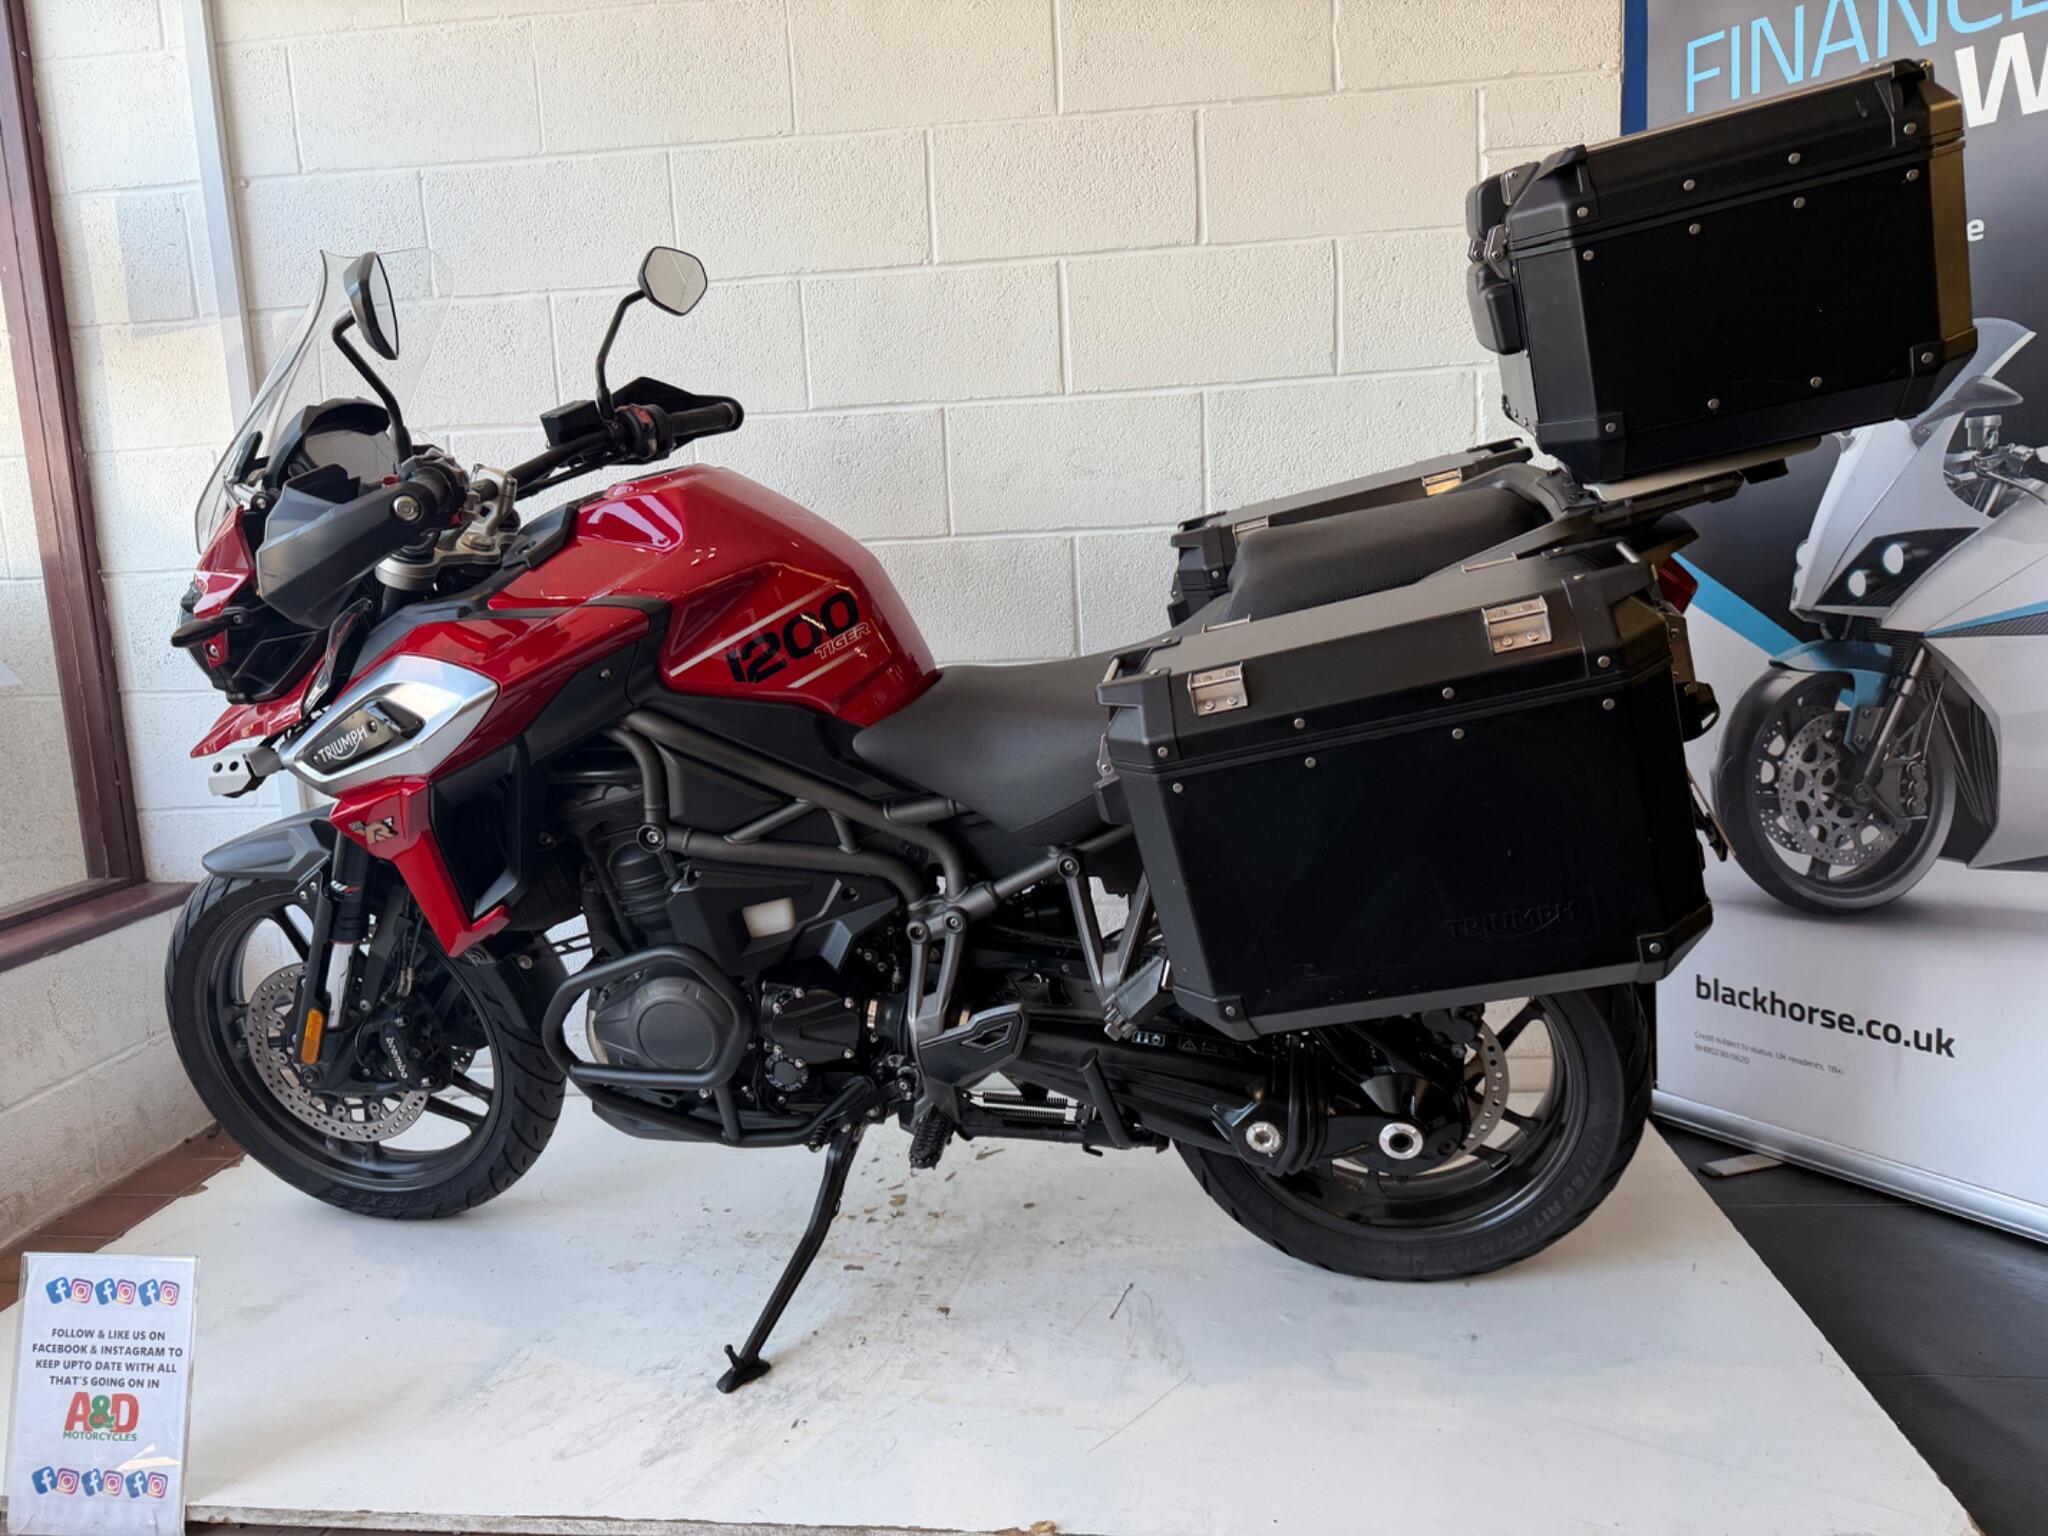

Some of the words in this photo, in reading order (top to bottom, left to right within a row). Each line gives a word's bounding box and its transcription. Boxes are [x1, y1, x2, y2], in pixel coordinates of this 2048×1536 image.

[1686, 0, 2048, 113] FINAN
[726, 591, 858, 683] 1200
[814, 622, 871, 660] TIGER
[318, 725, 368, 762] TRIUMPH
[1696, 974, 1955, 1058] blackhorse.co.uk
[386, 1036, 409, 1079] brembo
[32, 1343, 88, 1354] FACEBOOK
[90, 1345, 97, 1354] &
[101, 1346, 164, 1357] INSTAGRAM
[168, 1348, 183, 1357] TO
[51, 1328, 95, 1338] FOLLOW
[97, 1330, 105, 1338] &
[108, 1330, 129, 1340] LIKE
[132, 1331, 146, 1340] US
[149, 1331, 165, 1341] ON
[35, 1359, 60, 1369] KEEP
[63, 1360, 92, 1370] UPTO
[95, 1361, 122, 1371] DATE
[125, 1362, 154, 1372] WITH
[157, 1363, 177, 1373] ALL
[50, 1376, 88, 1386] THAT'S
[90, 1377, 125, 1387] GOING
[128, 1378, 144, 1388] ON
[147, 1379, 160, 1388] IN
[64, 1391, 139, 1433] A&D
[63, 1430, 137, 1442] MOTORCYCLES
